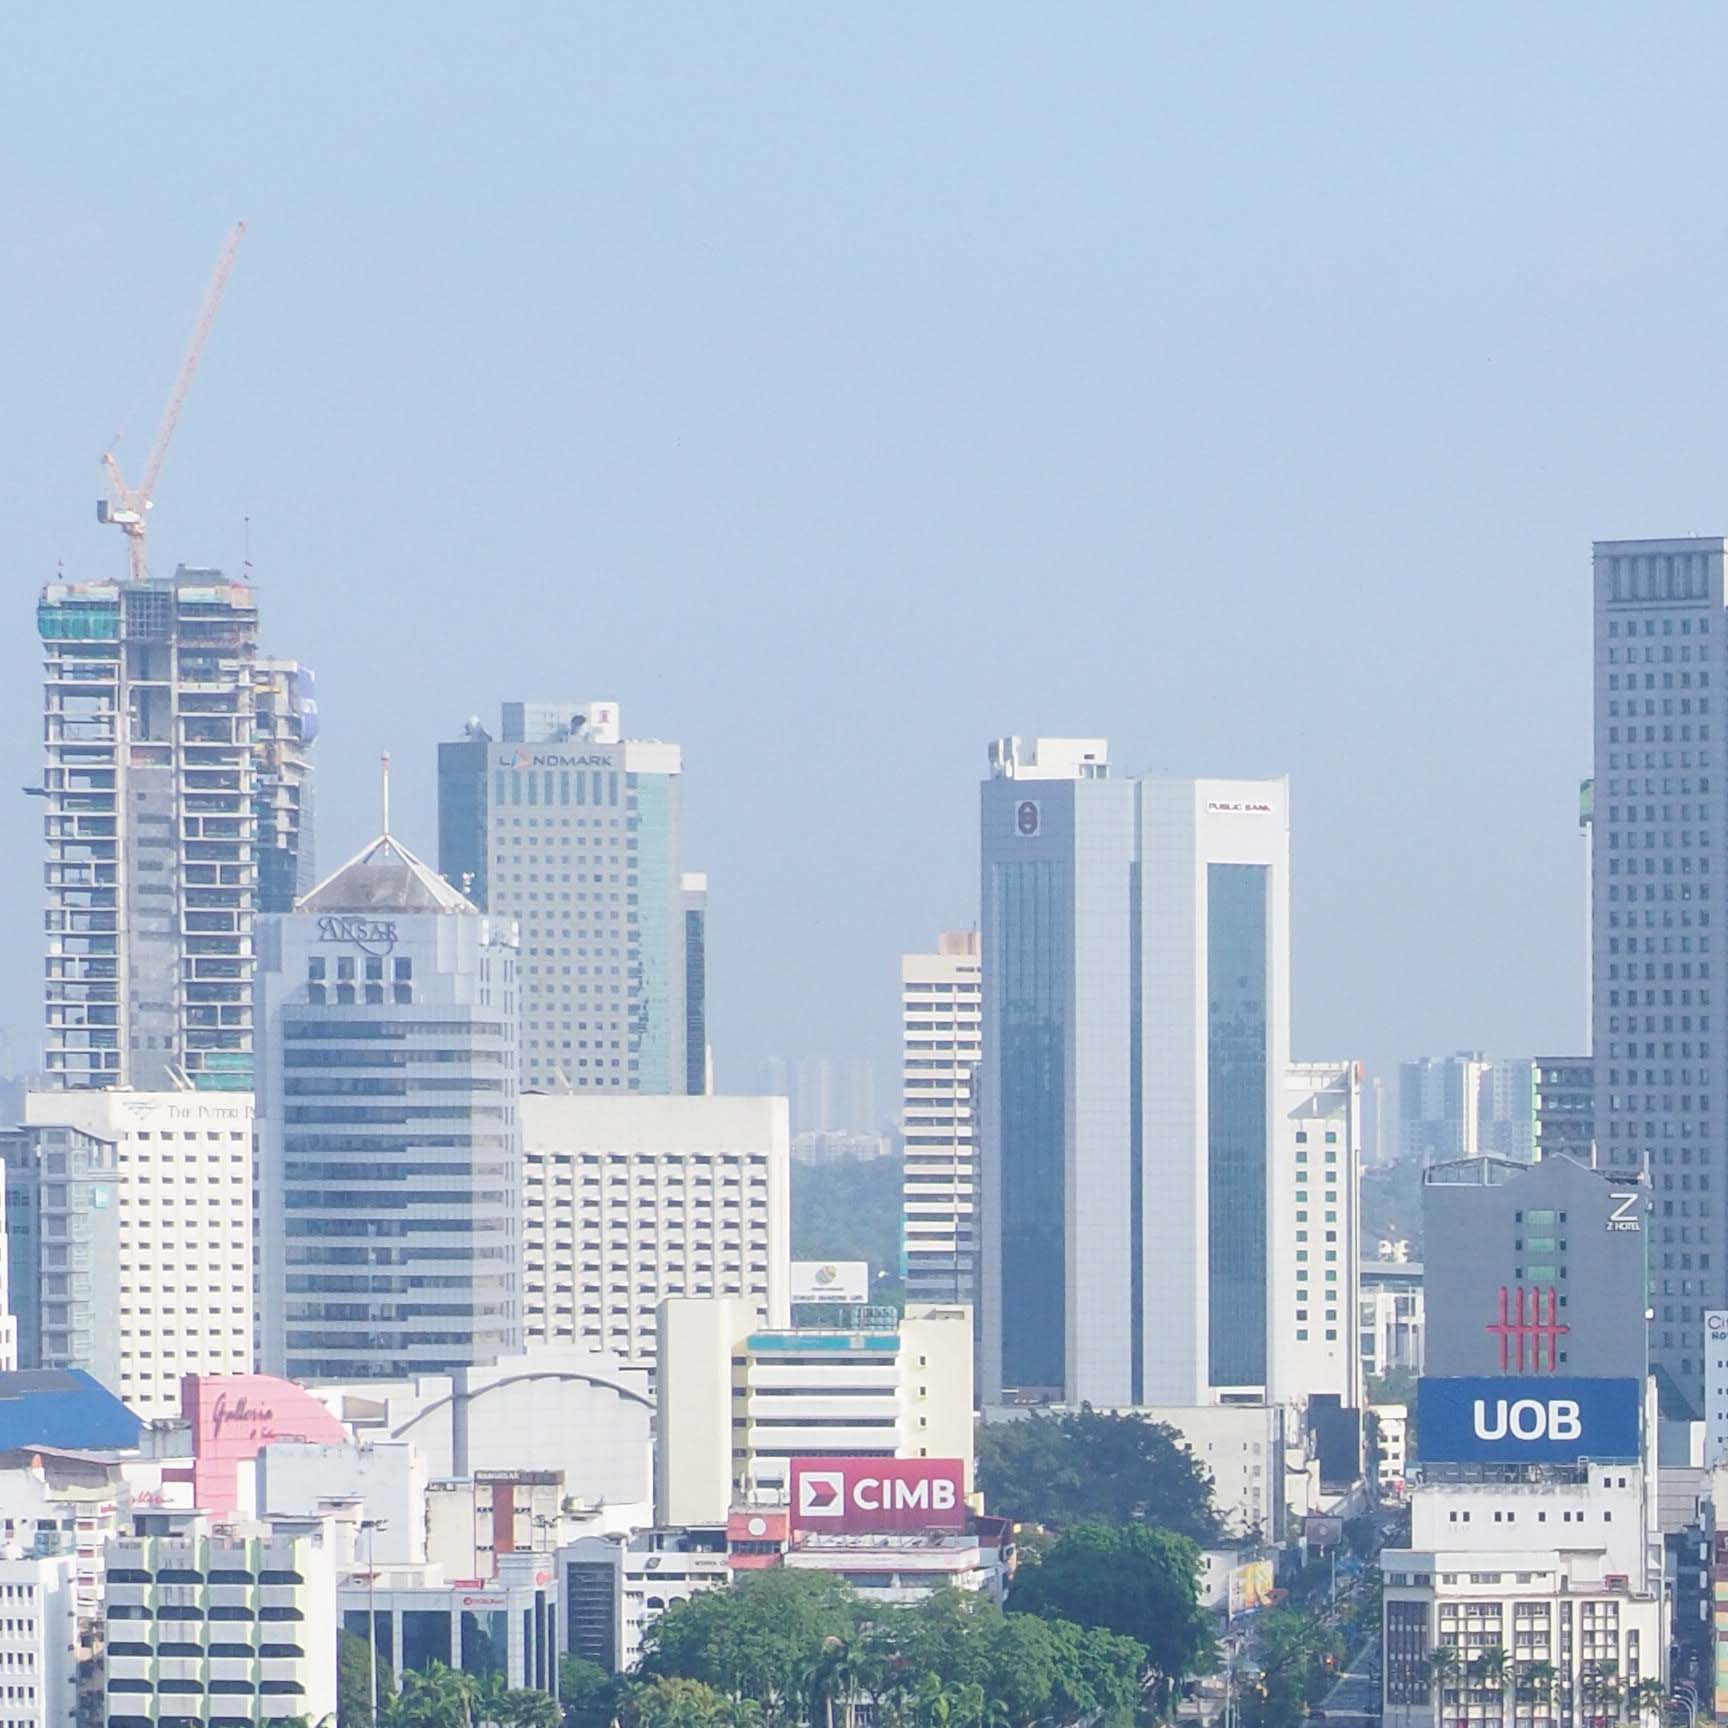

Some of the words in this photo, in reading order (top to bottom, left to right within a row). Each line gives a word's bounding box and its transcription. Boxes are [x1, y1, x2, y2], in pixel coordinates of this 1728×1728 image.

[1615, 1222, 1641, 1231] HOTEL
[1473, 1399, 1582, 1440] UOB
[852, 1478, 956, 1510] CIMB
